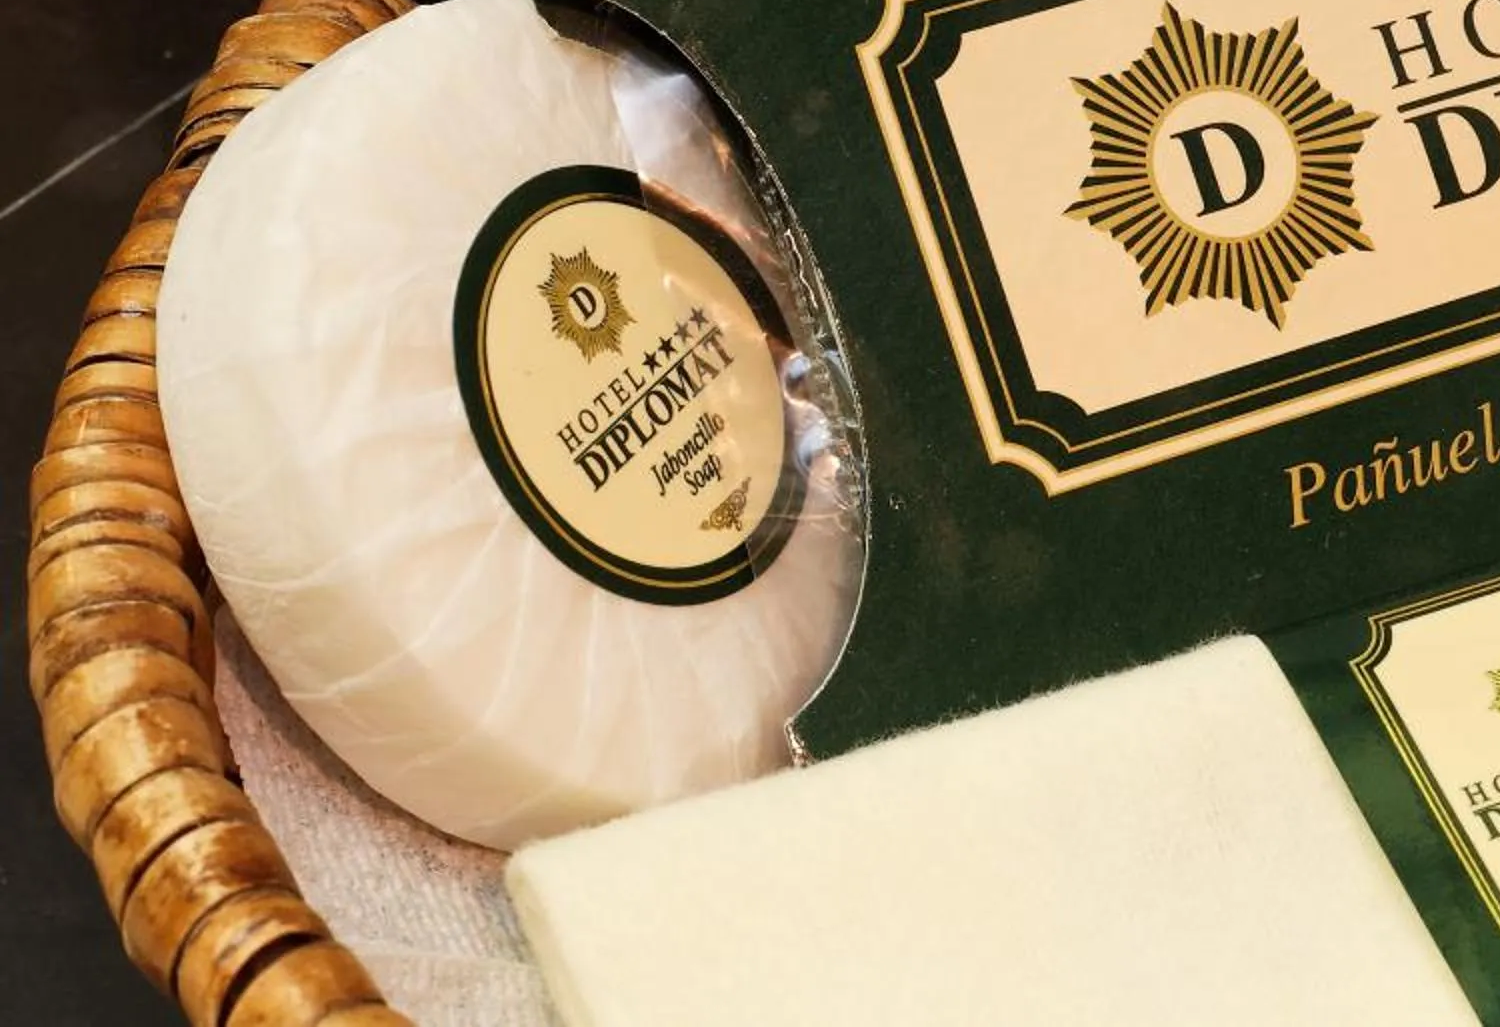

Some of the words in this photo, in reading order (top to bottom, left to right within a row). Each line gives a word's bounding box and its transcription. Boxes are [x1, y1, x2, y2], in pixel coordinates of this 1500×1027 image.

[1170, 120, 1267, 216] D
[569, 286, 598, 320] D
[557, 367, 646, 454] HOTEL
[574, 328, 736, 492] DIPLOMAT
[650, 412, 725, 497] Jaboncillo
[683, 453, 723, 496] Soap
